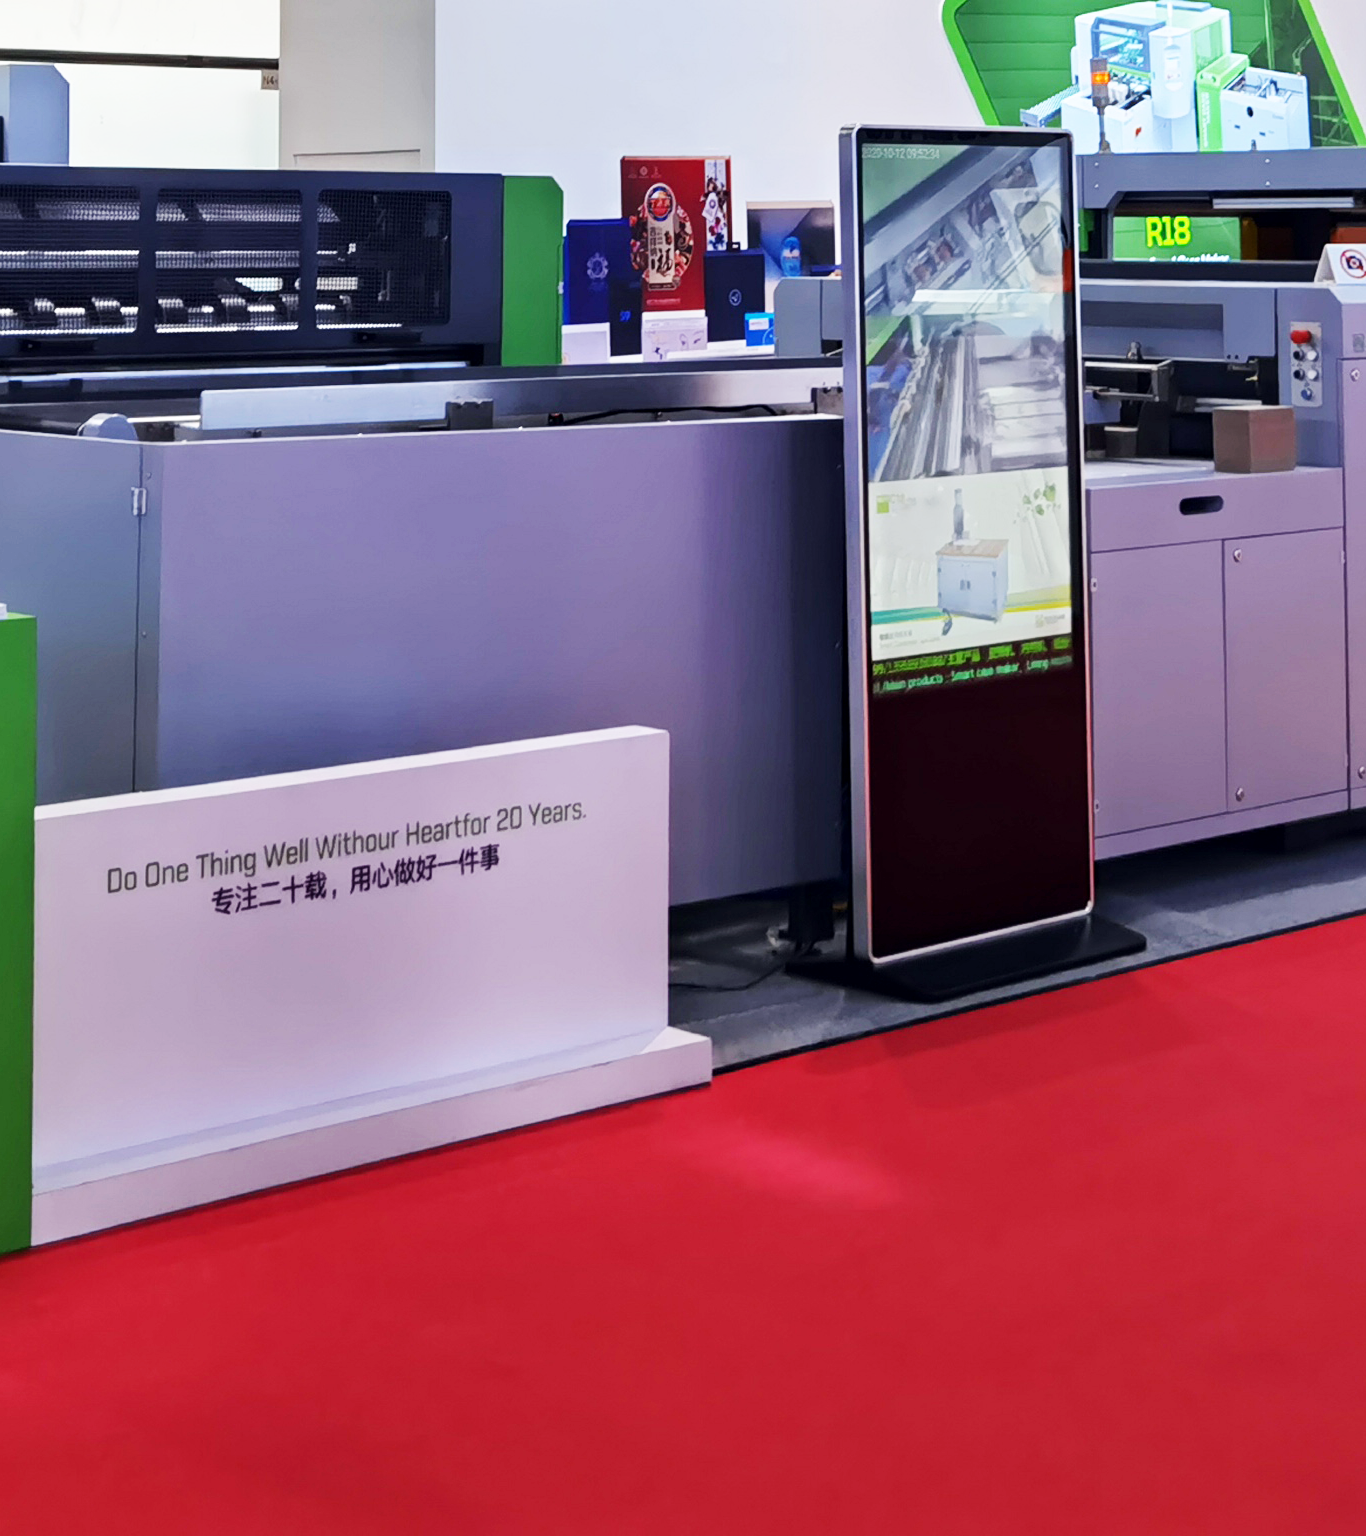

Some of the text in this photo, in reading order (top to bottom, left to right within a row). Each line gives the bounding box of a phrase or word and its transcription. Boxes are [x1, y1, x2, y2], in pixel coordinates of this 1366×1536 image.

[1145, 215, 1192, 248] R18
[107, 801, 588, 894] Do One Thing Well Withour Heartfor 20 Years.
